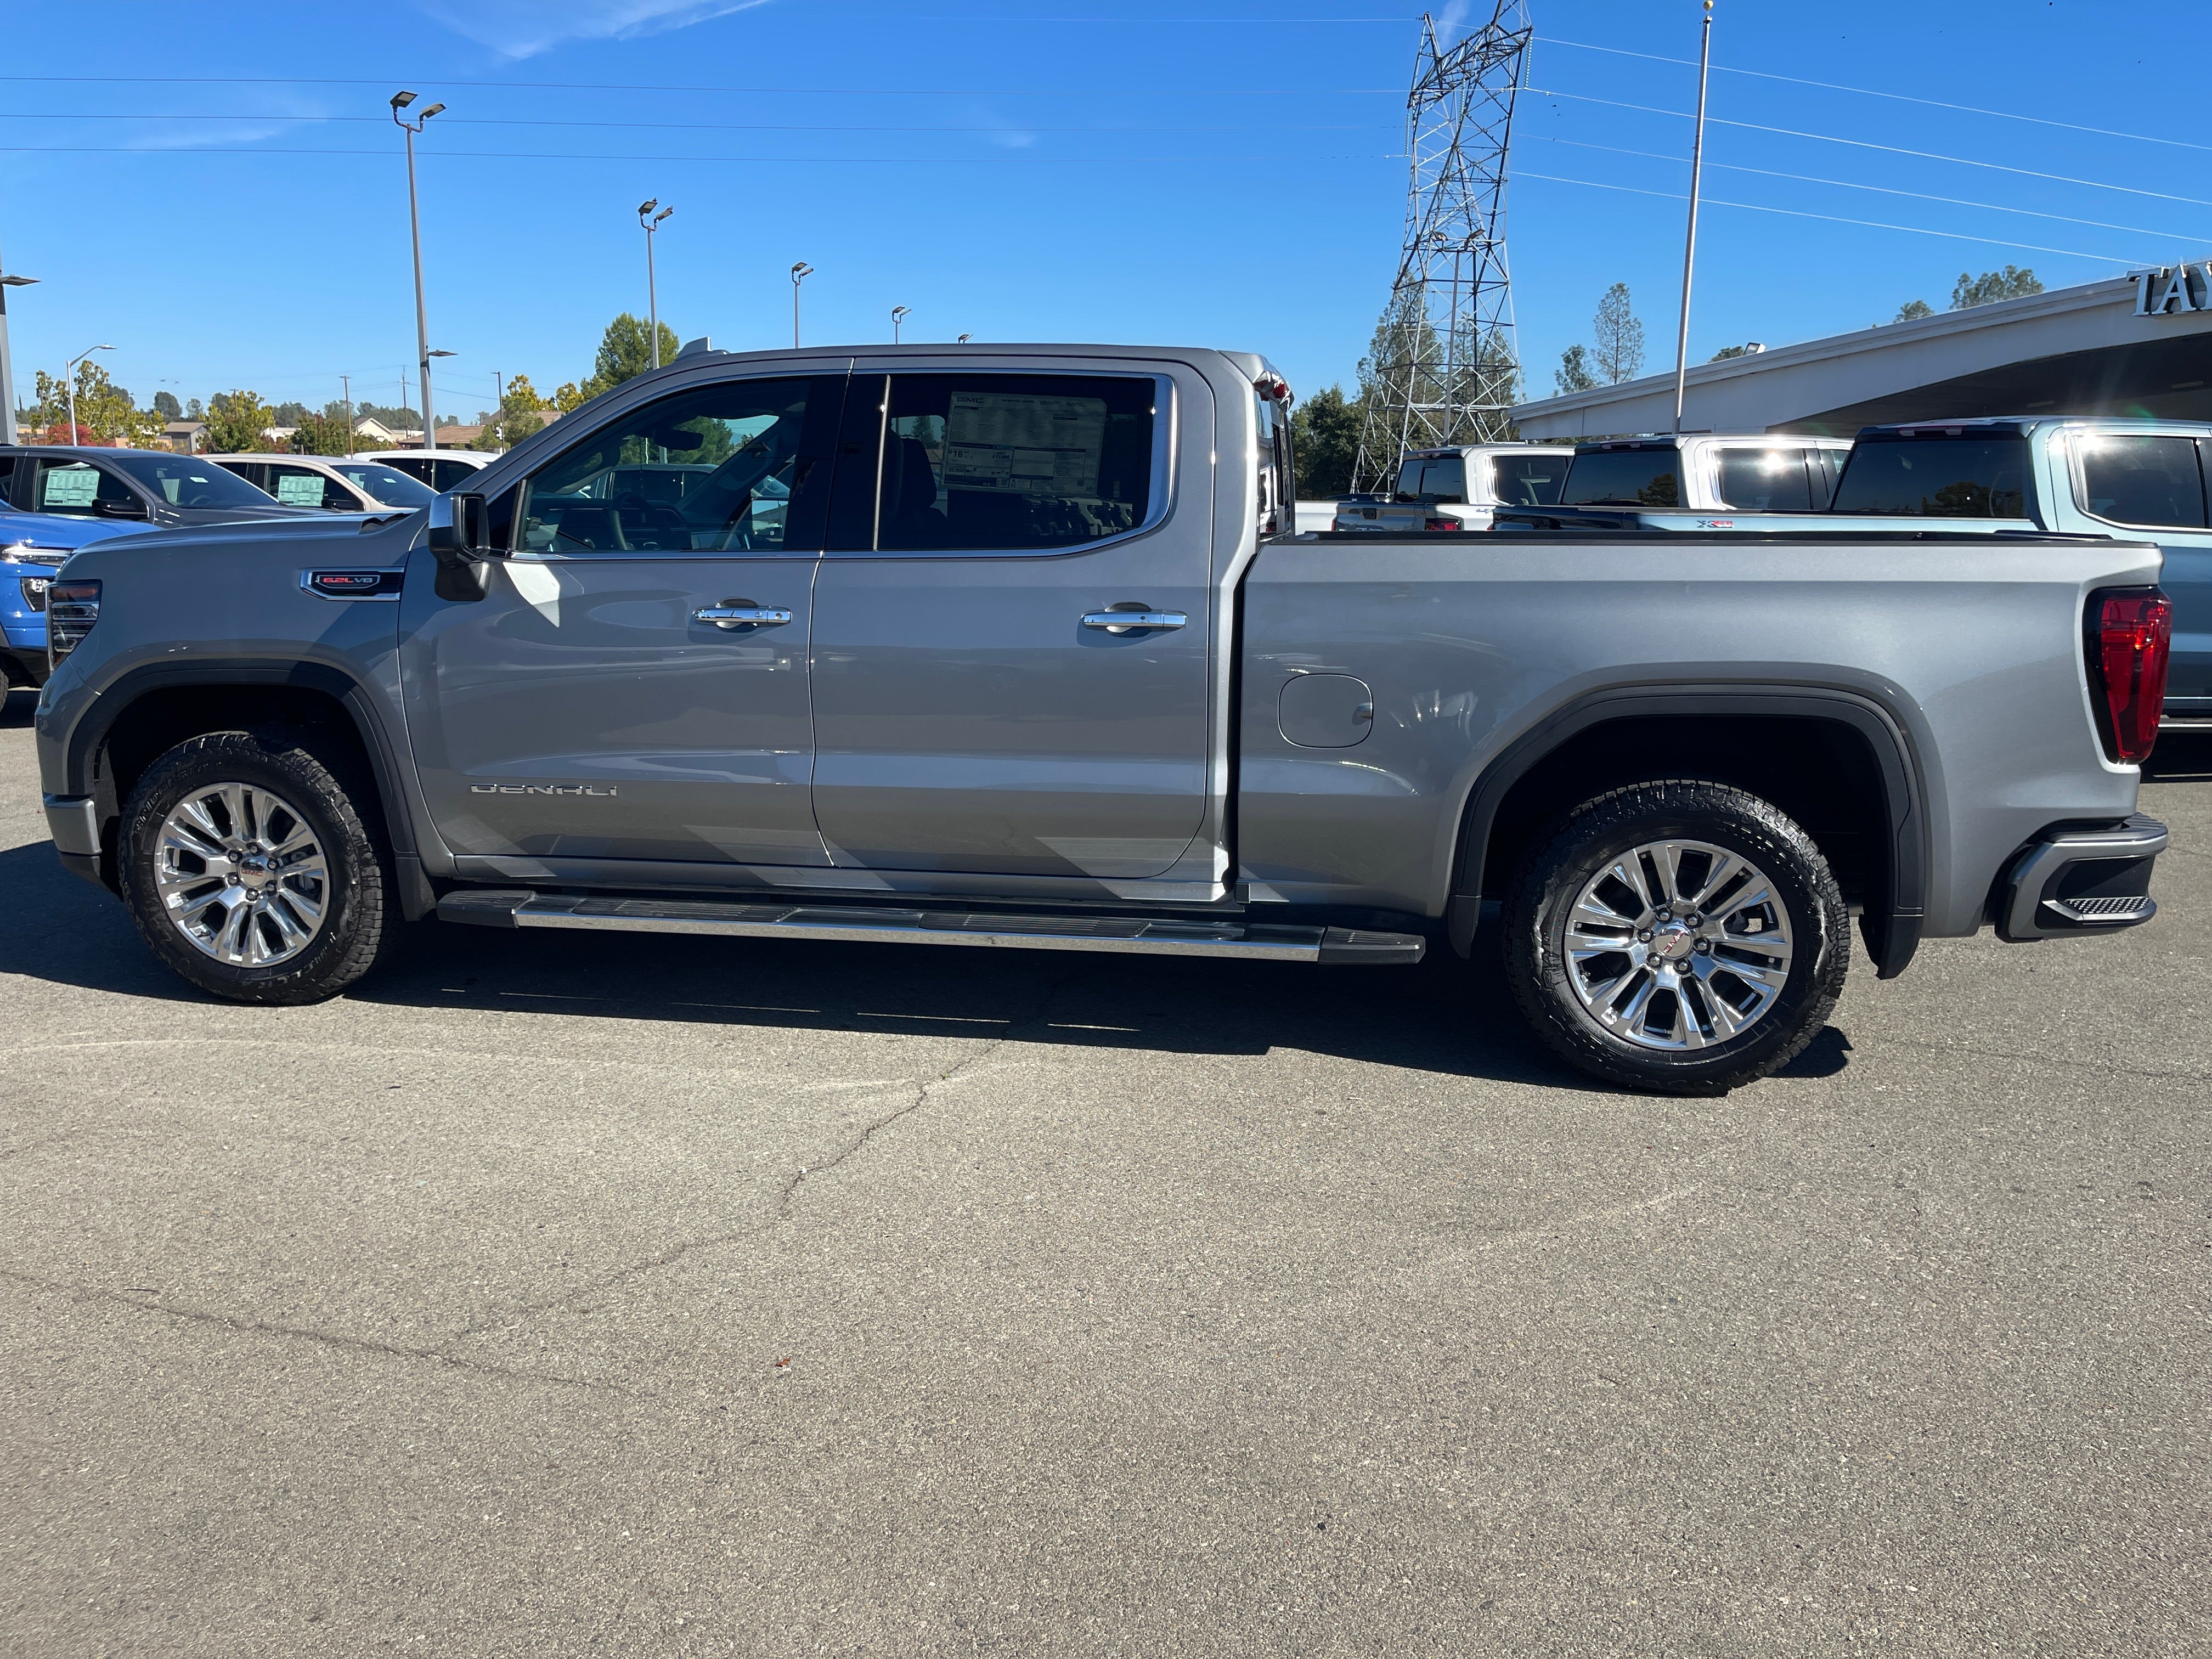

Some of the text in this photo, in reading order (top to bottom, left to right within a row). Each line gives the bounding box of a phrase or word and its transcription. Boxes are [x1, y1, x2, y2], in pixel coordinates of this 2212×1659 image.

[471, 783, 618, 796] DENALI
[241, 868, 263, 877] GMC
[1663, 929, 1686, 953] GMC
